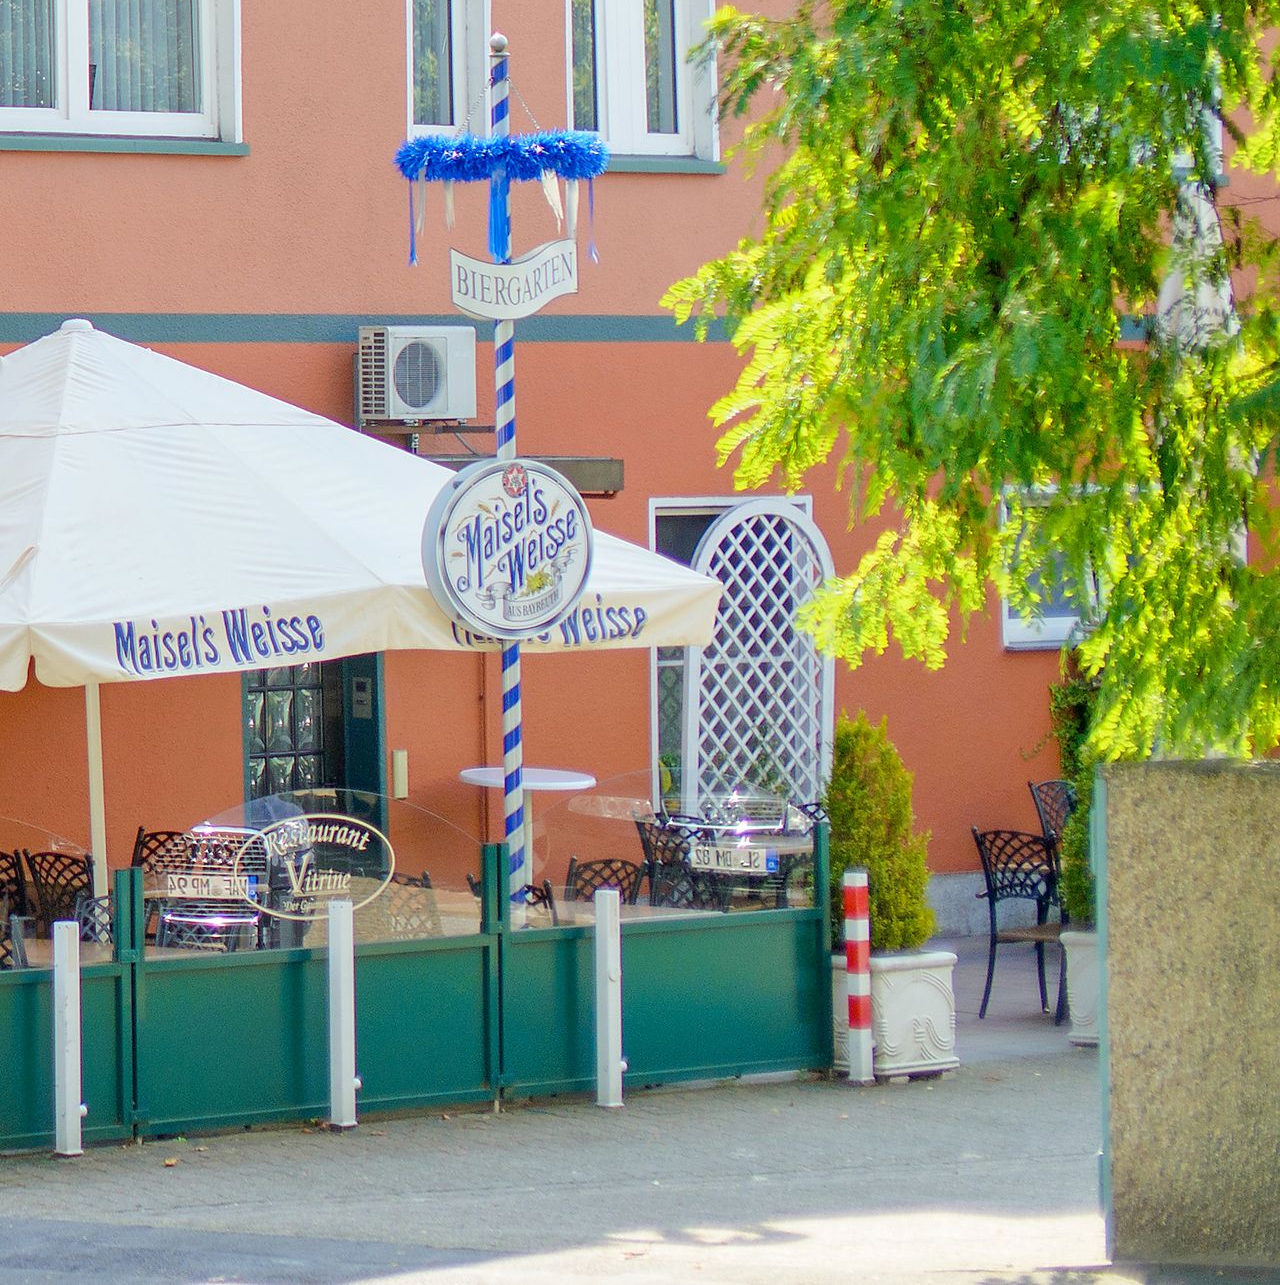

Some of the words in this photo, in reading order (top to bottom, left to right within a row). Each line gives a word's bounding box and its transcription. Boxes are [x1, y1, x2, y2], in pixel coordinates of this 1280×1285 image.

[456, 251, 573, 306] BIERGARTEN
[456, 478, 548, 593] Maisel's
[497, 508, 579, 594] Weisse
[523, 590, 559, 616] BAYREUTH
[113, 614, 221, 676] Maisel's
[221, 605, 325, 665] Weisse
[265, 823, 371, 858] Restaurant
[285, 851, 352, 896] Vitrine
